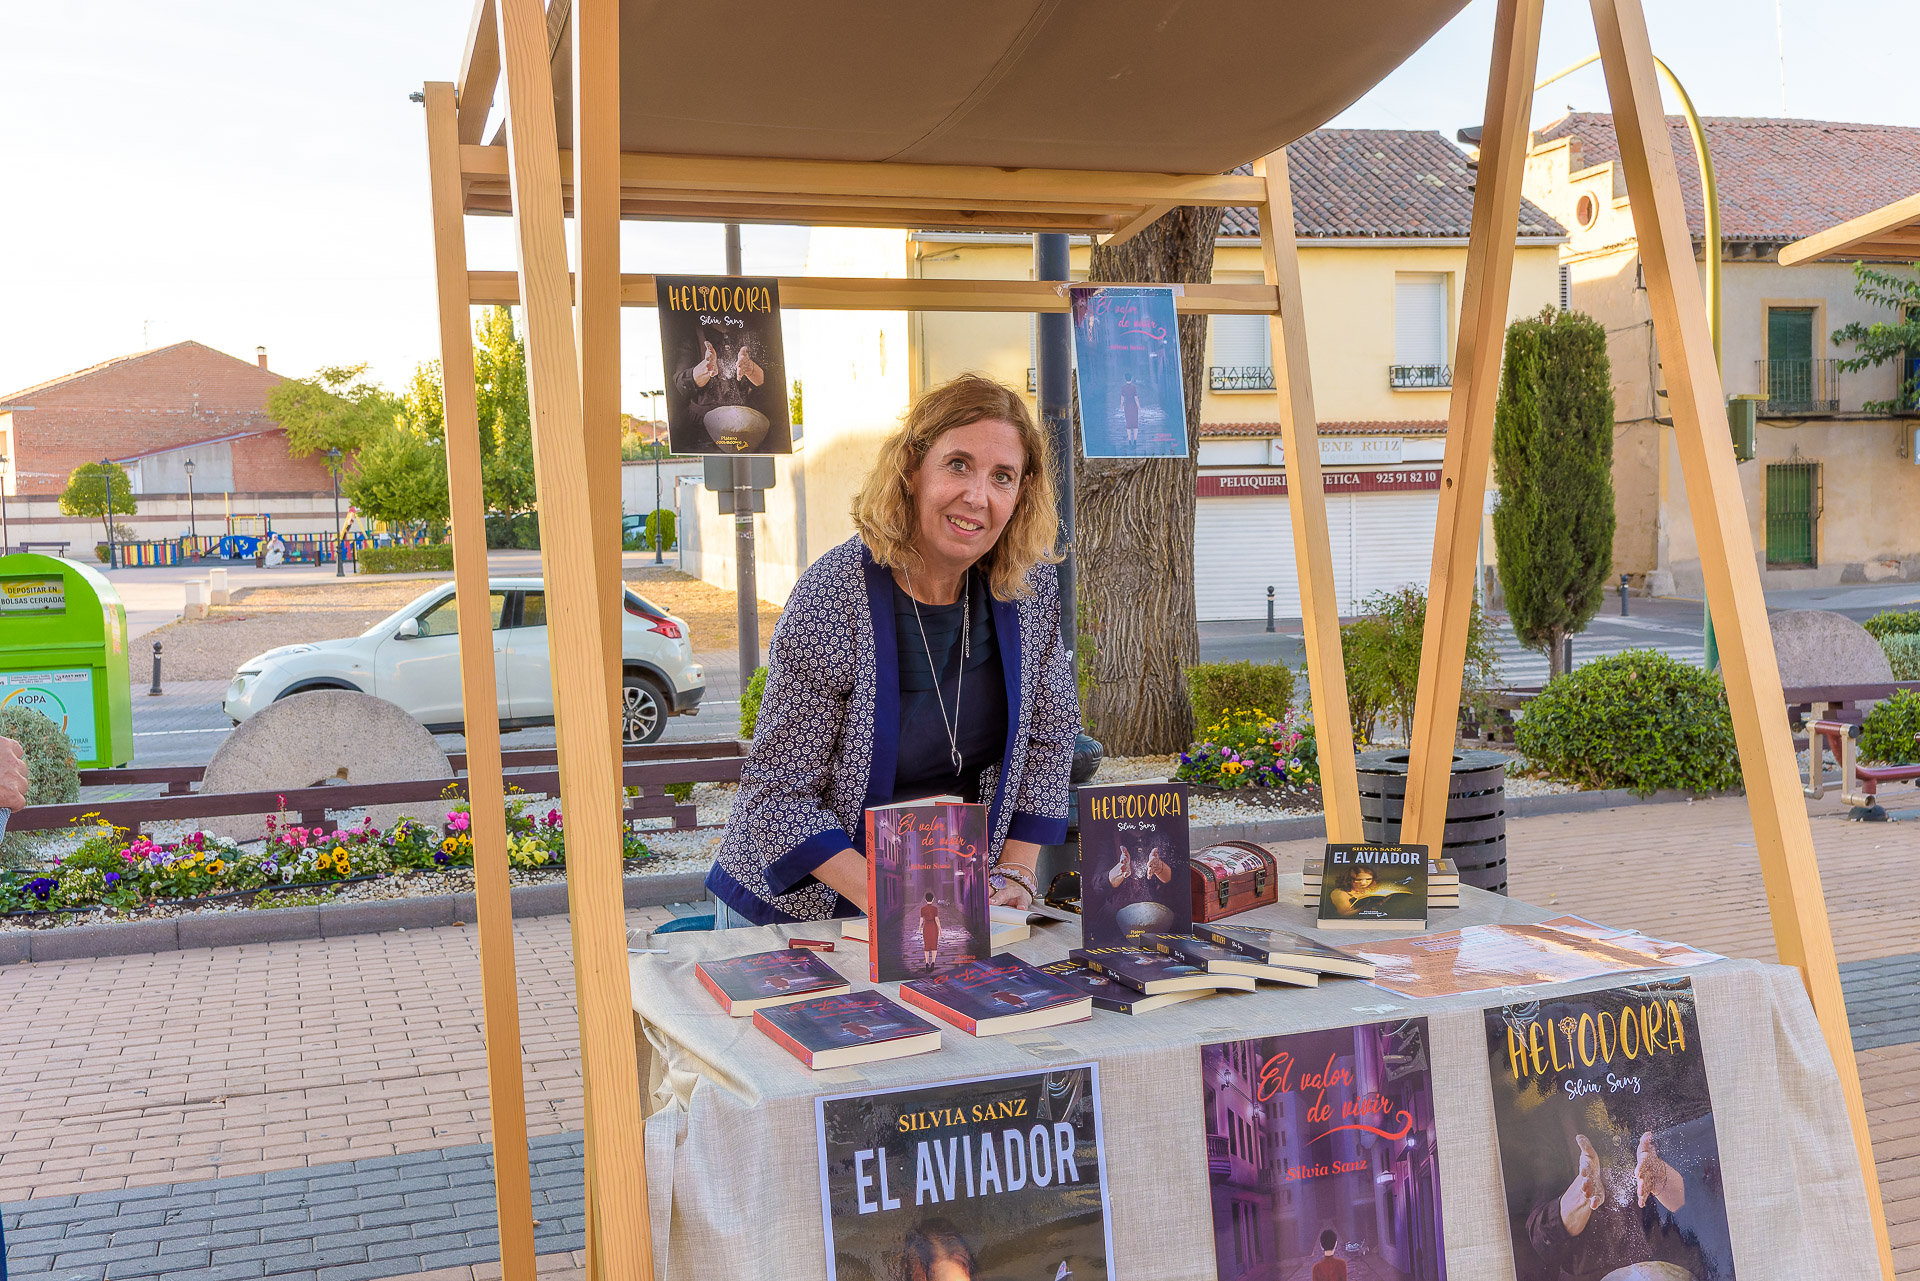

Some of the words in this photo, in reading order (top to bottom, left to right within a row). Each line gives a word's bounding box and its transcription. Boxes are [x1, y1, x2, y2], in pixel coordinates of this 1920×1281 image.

[668, 285, 772, 314] HELIODORA
[1096, 296, 1112, 316] El
[700, 315, 721, 326] Silvia
[724, 315, 745, 328] Sanz
[1320, 441, 1353, 453] ENE
[1362, 440, 1400, 452] RUIZ
[1220, 474, 1287, 490] PELUQUERI
[1376, 472, 1394, 484] 925
[1396, 472, 1407, 483] 91
[1410, 471, 1423, 483] 82
[1425, 471, 1437, 482] 10
[7, 586, 47, 594] DEPOSITAR
[48, 585, 58, 593] EN
[30, 596, 65, 604] CERRADAS
[18, 695, 47, 704] ROPA
[1091, 792, 1181, 820] HELIODORA
[897, 813, 916, 835] El
[918, 815, 944, 832] valor
[1117, 822, 1137, 832] Silvia
[1138, 821, 1157, 831] Sanz
[921, 831, 935, 846] de
[1333, 851, 1350, 864] EL
[1355, 852, 1421, 865] AVIADOR
[1507, 1000, 1686, 1079] HELIODORA
[1257, 1051, 1295, 1102] El
[1300, 1052, 1354, 1092] valor
[1564, 1079, 1602, 1100] Silvia
[1606, 1072, 1641, 1094] Sanz
[899, 1107, 967, 1133] SILVIA
[972, 1098, 1028, 1122] SANZ
[1307, 1088, 1336, 1123] de
[1342, 1093, 1394, 1119] vivir
[854, 1147, 901, 1215] EL
[915, 1121, 1080, 1206] AVIADOR
[1286, 1164, 1329, 1181] Silvia
[1331, 1160, 1368, 1175] Sanz
